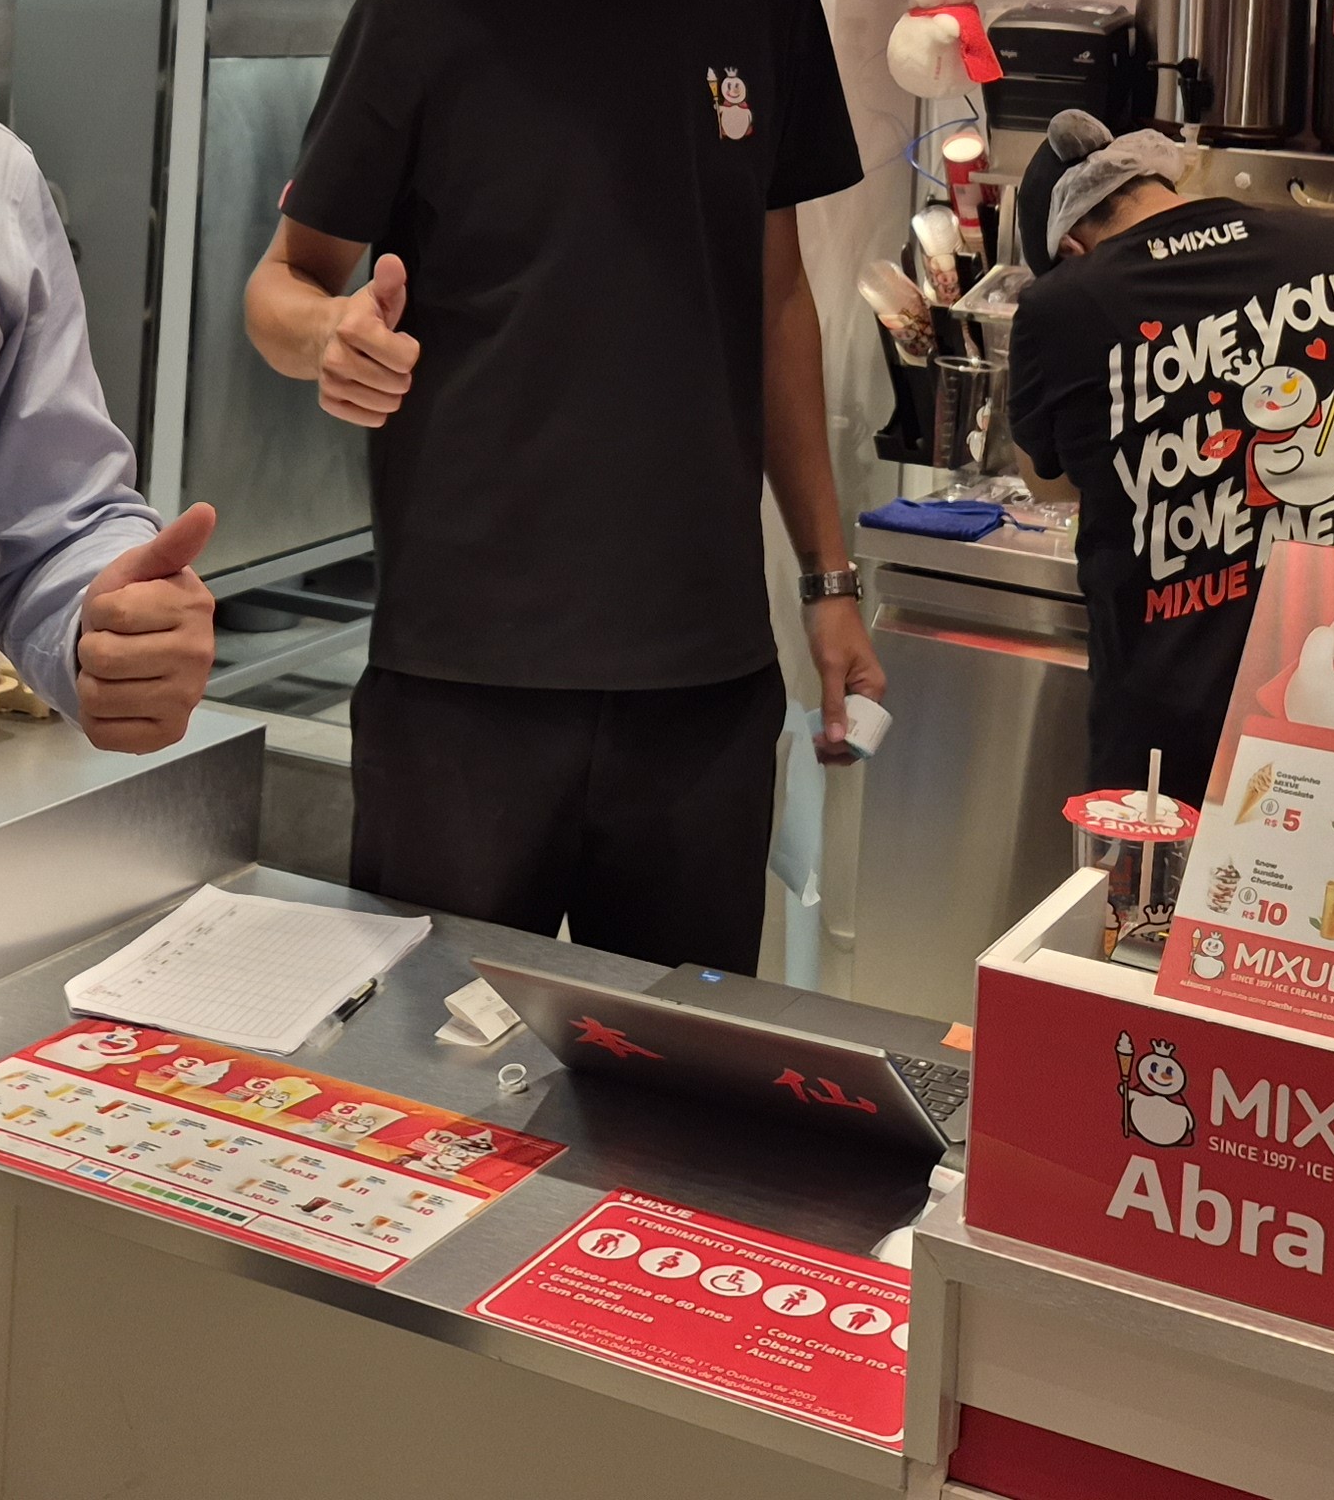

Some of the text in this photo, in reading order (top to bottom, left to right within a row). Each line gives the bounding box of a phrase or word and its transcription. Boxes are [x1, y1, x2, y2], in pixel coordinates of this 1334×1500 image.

[1168, 220, 1249, 256] MIXUE
[1109, 341, 1123, 442] I
[1133, 308, 1240, 425] LOVE
[1112, 409, 1226, 557] YOU
[1149, 477, 1254, 581] LOVE
[1144, 560, 1249, 624] MIXUE
[1104, 821, 1177, 836] MIXUE
[1208, 1136, 1259, 1162] SINCE
[631, 1194, 697, 1220] MIXUE
[1105, 1154, 1325, 1275] Abra
[626, 1214, 735, 1253] ATENDIMENTO
[735, 1247, 845, 1286] PREFERENCIAL
[846, 1279, 856, 1290] E
[538, 1281, 655, 1324] Com Deficiência
[549, 1272, 623, 1301] Gestantes
[559, 1263, 735, 1323] Idosos acima de 60 anos
[746, 1345, 813, 1374] Autistas
[757, 1336, 815, 1361] Obesas
[767, 1326, 888, 1372] Com Criança no
